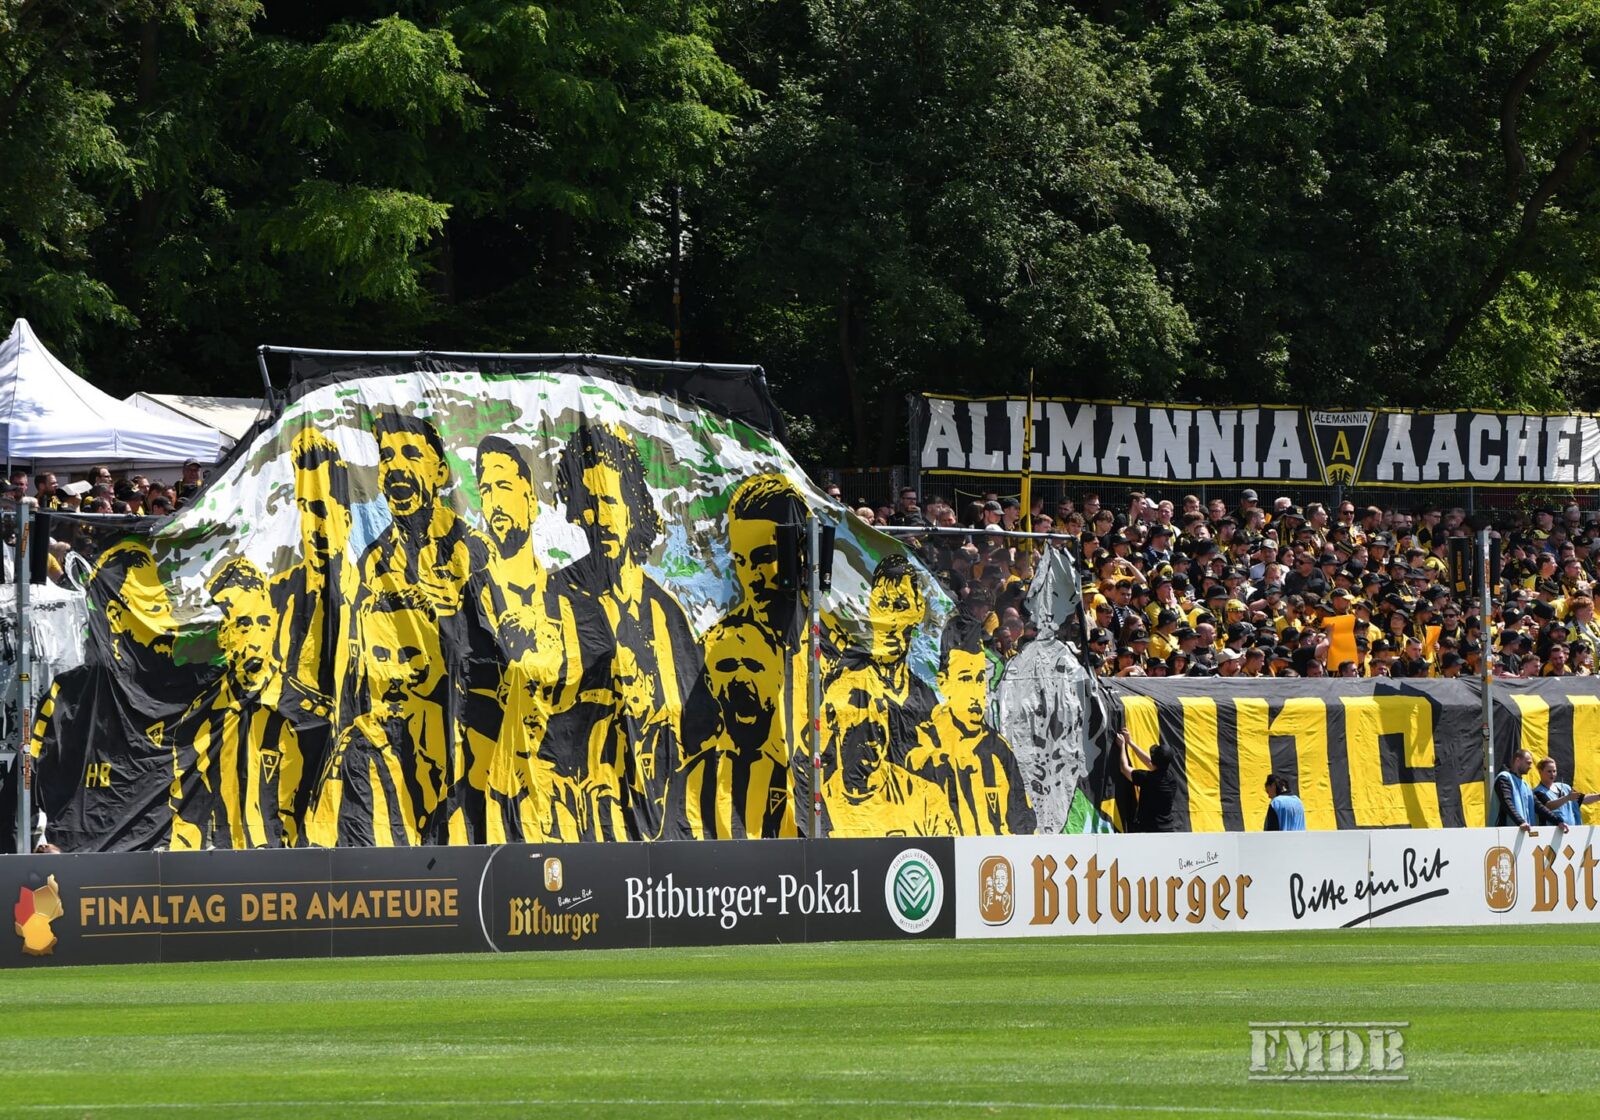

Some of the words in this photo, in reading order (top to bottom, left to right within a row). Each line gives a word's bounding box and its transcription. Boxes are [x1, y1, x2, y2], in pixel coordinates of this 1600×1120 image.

[921, 398, 1307, 479] ALEMANNIA
[1314, 412, 1369, 424] ALEMANNIA
[1331, 430, 1350, 460] A
[80, 895, 226, 926] FINALTAG
[241, 892, 298, 922] DER
[306, 888, 459, 919] AMATEURE
[625, 868, 862, 930] Bitburger-Pokal
[1028, 853, 1253, 925] Bitburger
[1289, 873, 1348, 920] Bitte
[1354, 870, 1399, 901] ein
[1403, 848, 1450, 888] Bit
[507, 897, 600, 941] Bitburger
